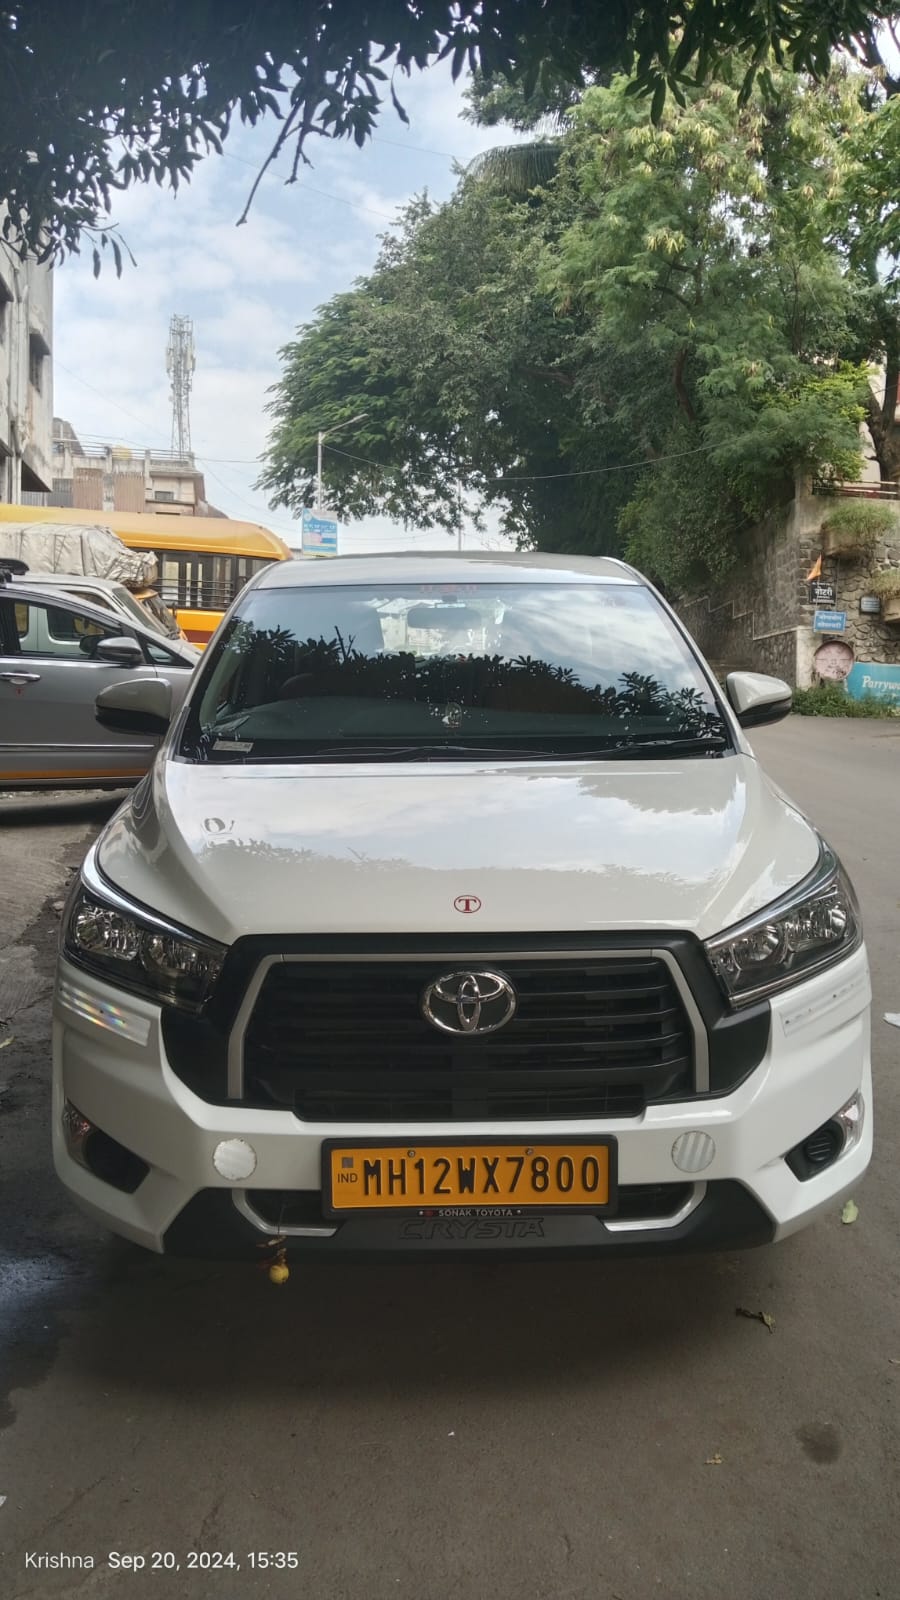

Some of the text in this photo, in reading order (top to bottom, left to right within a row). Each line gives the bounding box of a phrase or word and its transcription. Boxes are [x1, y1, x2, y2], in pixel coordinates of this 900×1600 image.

[457, 898, 477, 912] T
[337, 1172, 358, 1184] IND
[363, 1156, 600, 1196] MH12WX7800
[438, 1208, 513, 1217] SONAK TOYOTA
[399, 1217, 545, 1240] CRYSTA
